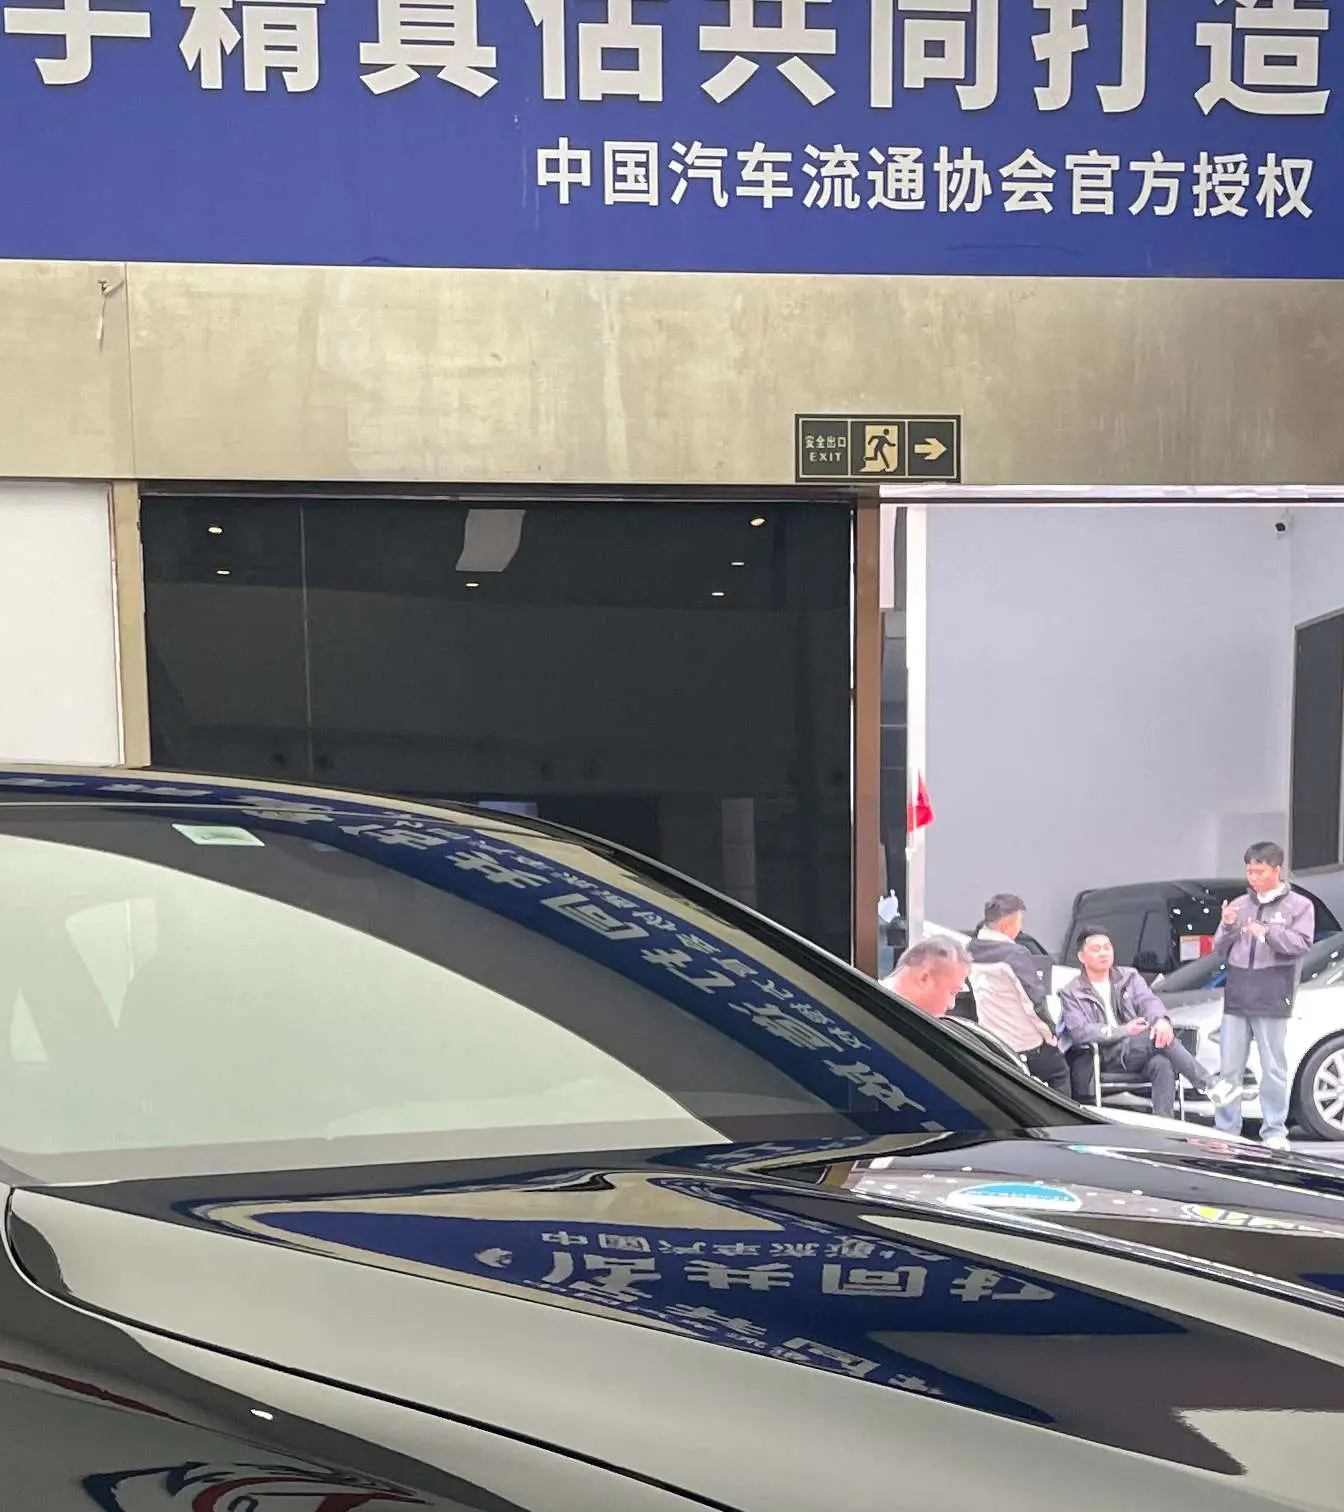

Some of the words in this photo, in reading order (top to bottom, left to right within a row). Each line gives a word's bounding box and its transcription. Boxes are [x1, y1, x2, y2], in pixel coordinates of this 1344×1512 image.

[536, 136, 1315, 220] 中国汽车流通协会官方授权
[805, 435, 846, 449] 安全出口
[809, 452, 842, 461] EXIT
